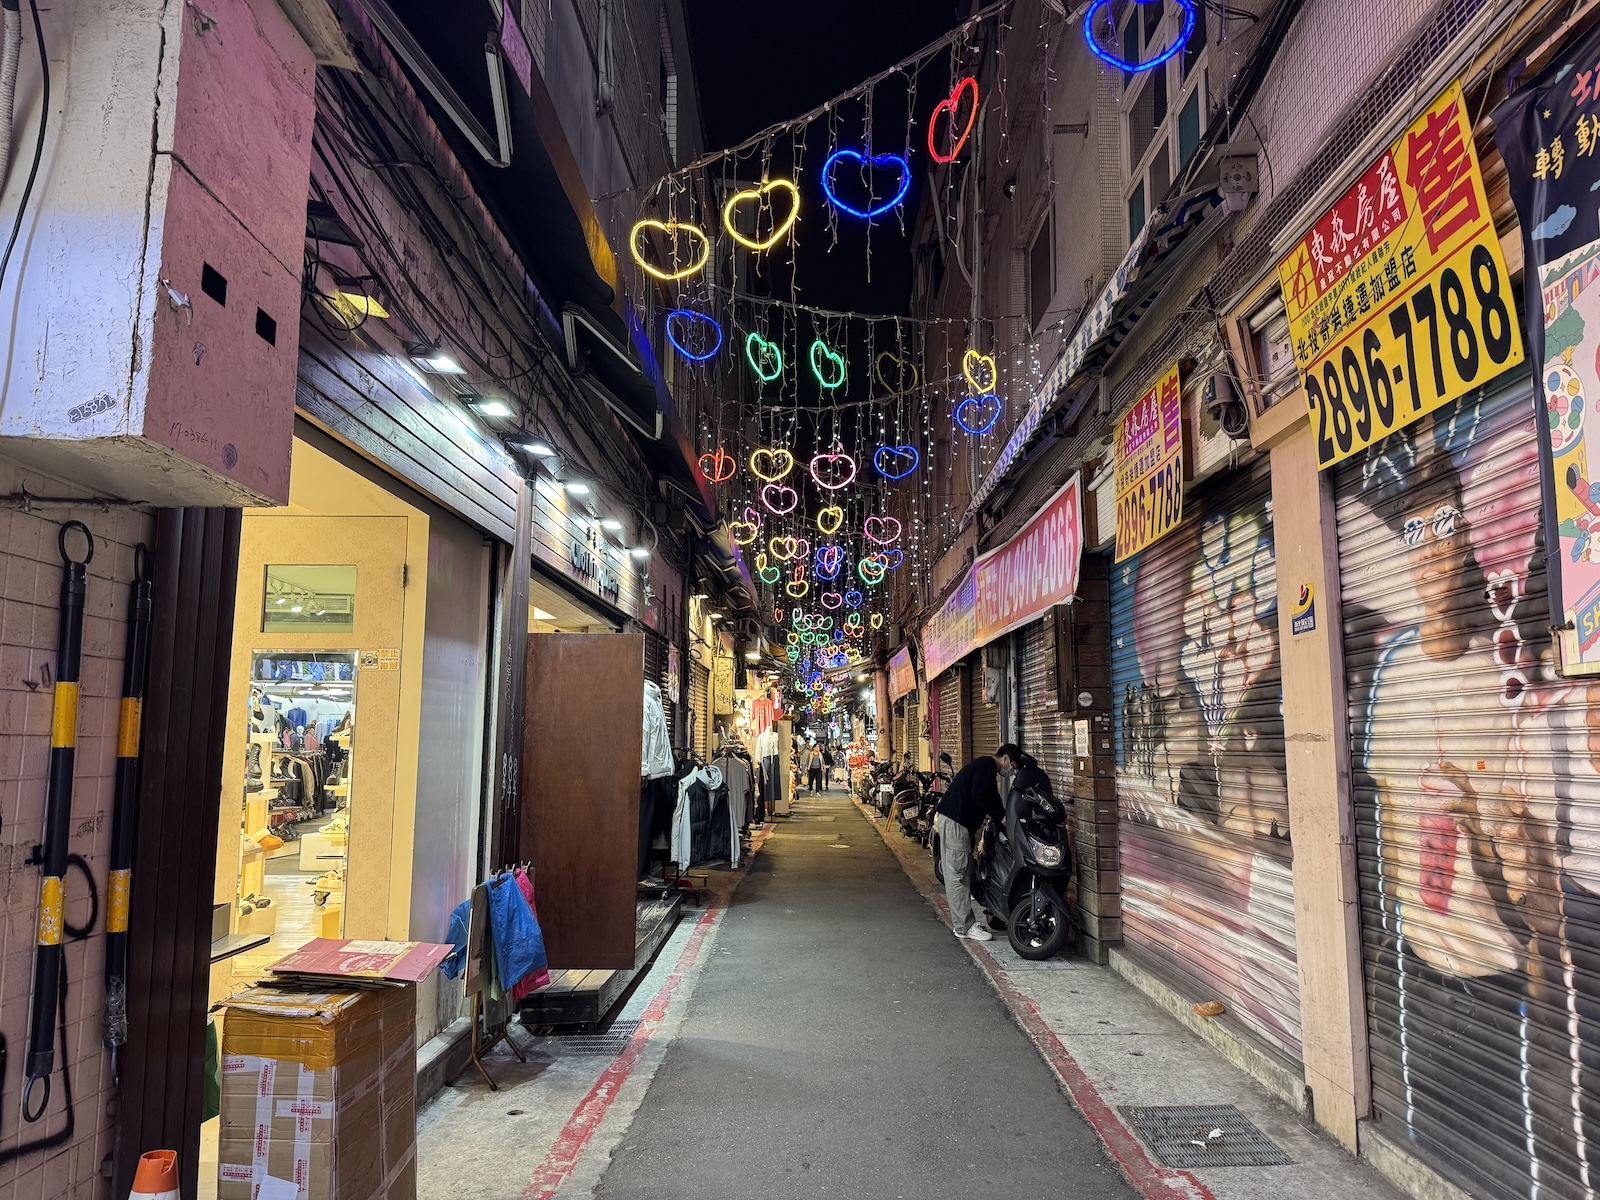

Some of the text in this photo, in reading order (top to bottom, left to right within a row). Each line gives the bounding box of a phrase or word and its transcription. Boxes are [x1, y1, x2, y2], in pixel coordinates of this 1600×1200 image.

[1310, 155, 1401, 279] 東森房屋
[1406, 100, 1480, 252] 售
[1160, 375, 1180, 454] 售
[1308, 243, 1512, 464] 2896-7788
[1124, 389, 1159, 444] 東森房屋
[998, 499, 1074, 621] 02-8978-2666
[1116, 455, 1181, 559] 2896-7788
